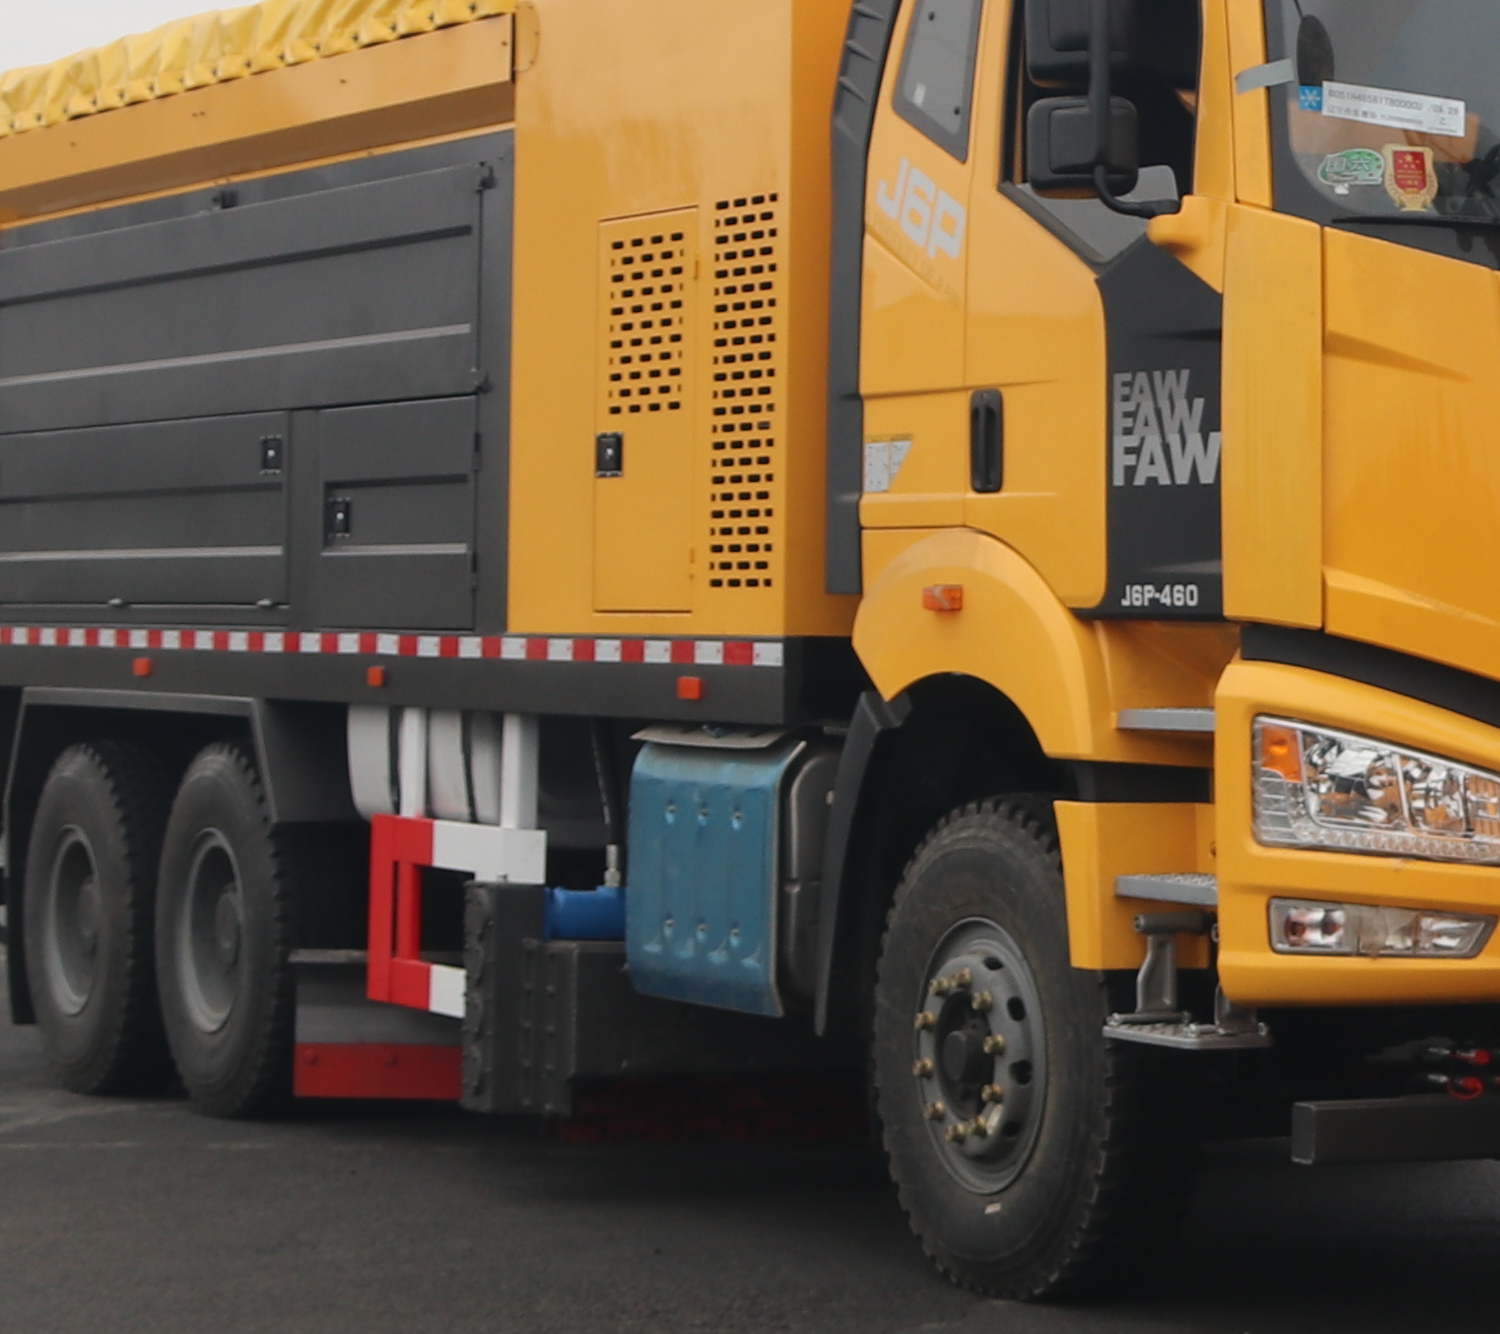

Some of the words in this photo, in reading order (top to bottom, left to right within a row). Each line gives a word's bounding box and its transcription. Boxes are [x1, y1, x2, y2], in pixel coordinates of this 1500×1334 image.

[876, 157, 967, 259] J6P
[1113, 369, 1190, 405] FAW
[1113, 398, 1205, 440] FAW
[1113, 432, 1222, 486] FAW
[1120, 584, 1200, 608] J6P-460
